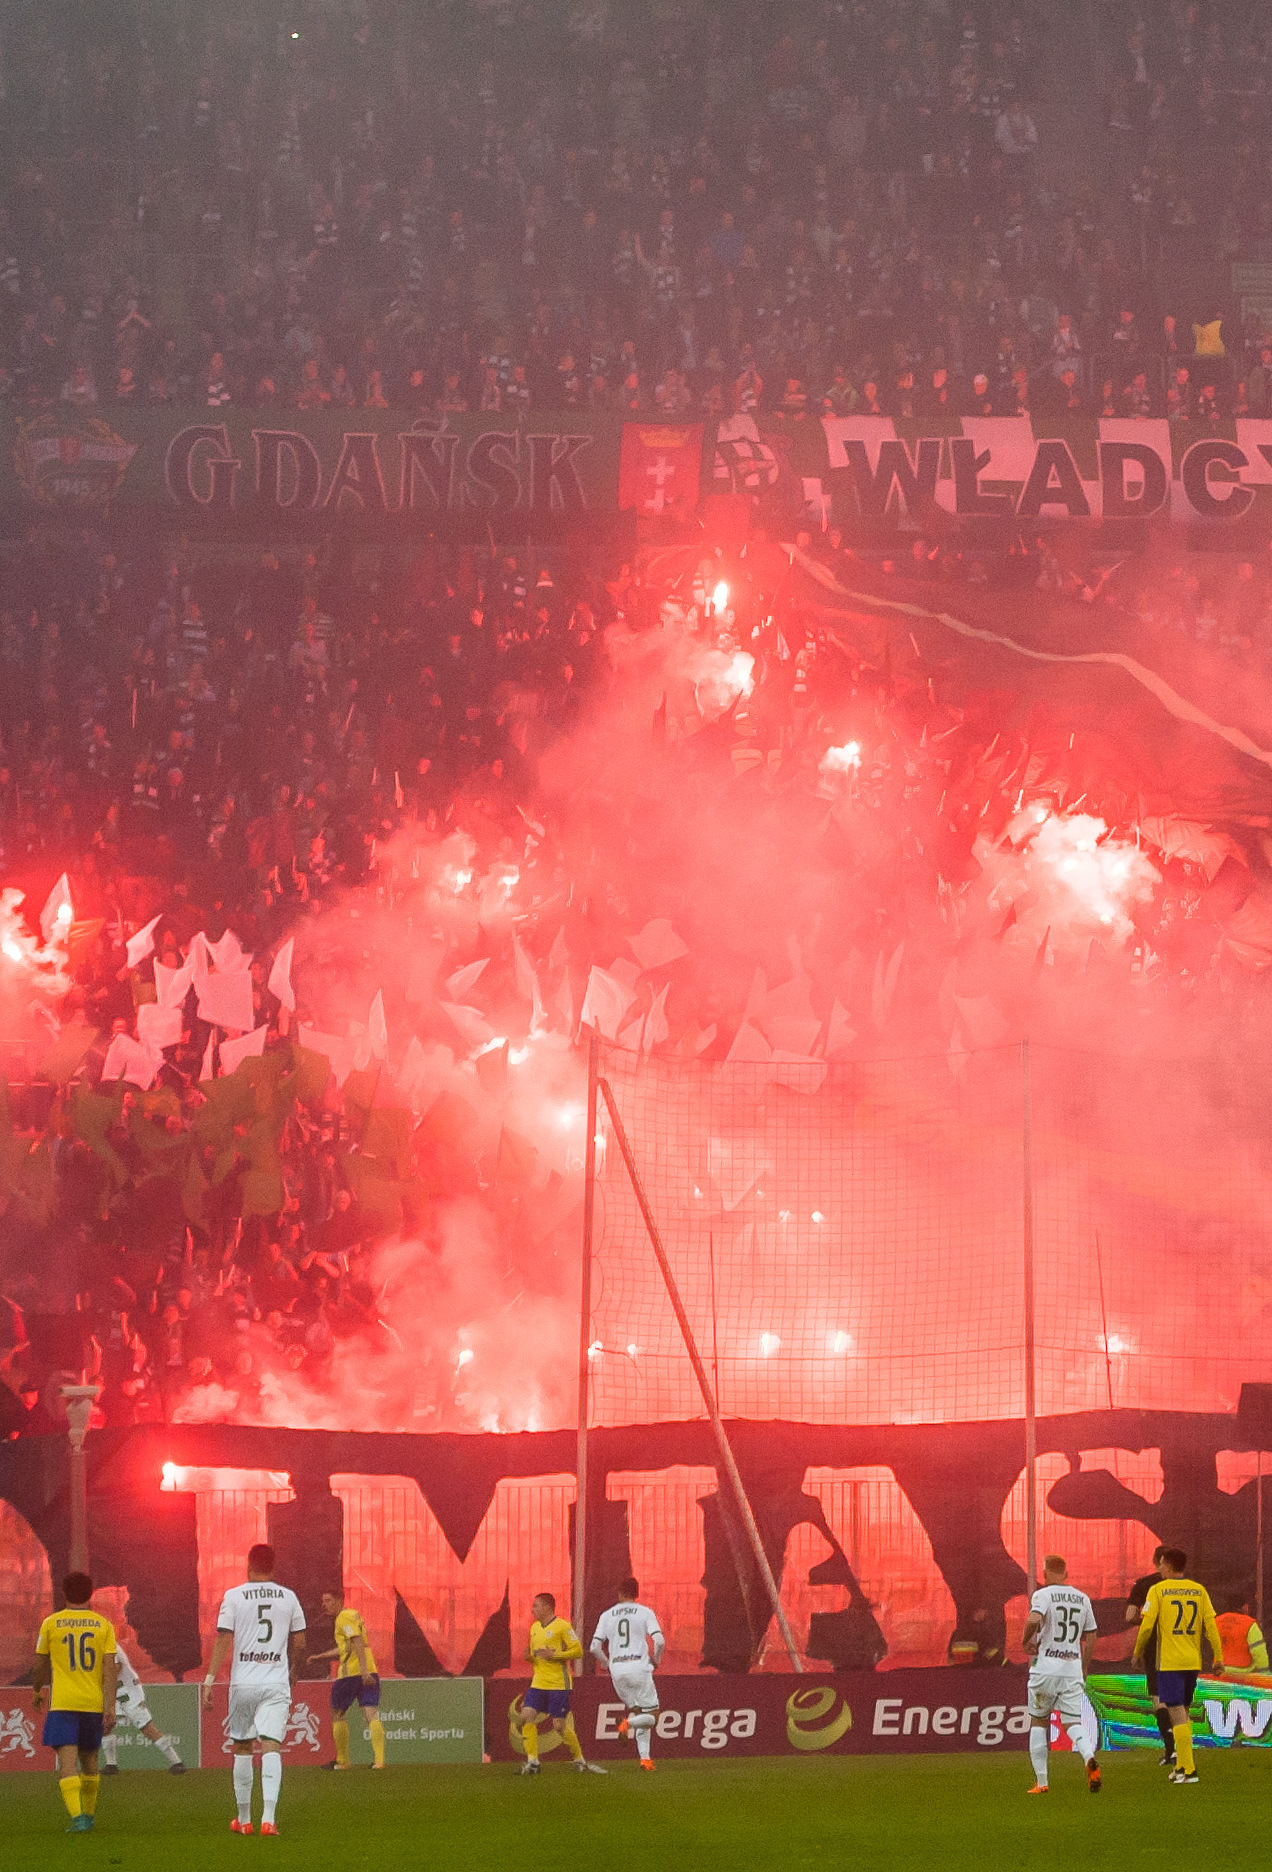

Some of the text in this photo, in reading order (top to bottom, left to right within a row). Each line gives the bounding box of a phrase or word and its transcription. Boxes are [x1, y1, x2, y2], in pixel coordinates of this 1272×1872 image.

[164, 418, 593, 510] GDAŃSK
[242, 1585, 285, 1600] VITÓRIA
[56, 1618, 101, 1629] ESQUEDA
[257, 1604, 273, 1644] 5
[611, 1607, 638, 1618] LIPSKI
[1053, 1605, 1082, 1644] 35
[1171, 1600, 1199, 1636] 22
[617, 1618, 631, 1649] 9
[62, 1632, 96, 1672] 16
[420, 1728, 464, 1744] Sportu
[872, 1699, 1032, 1745] Energa
